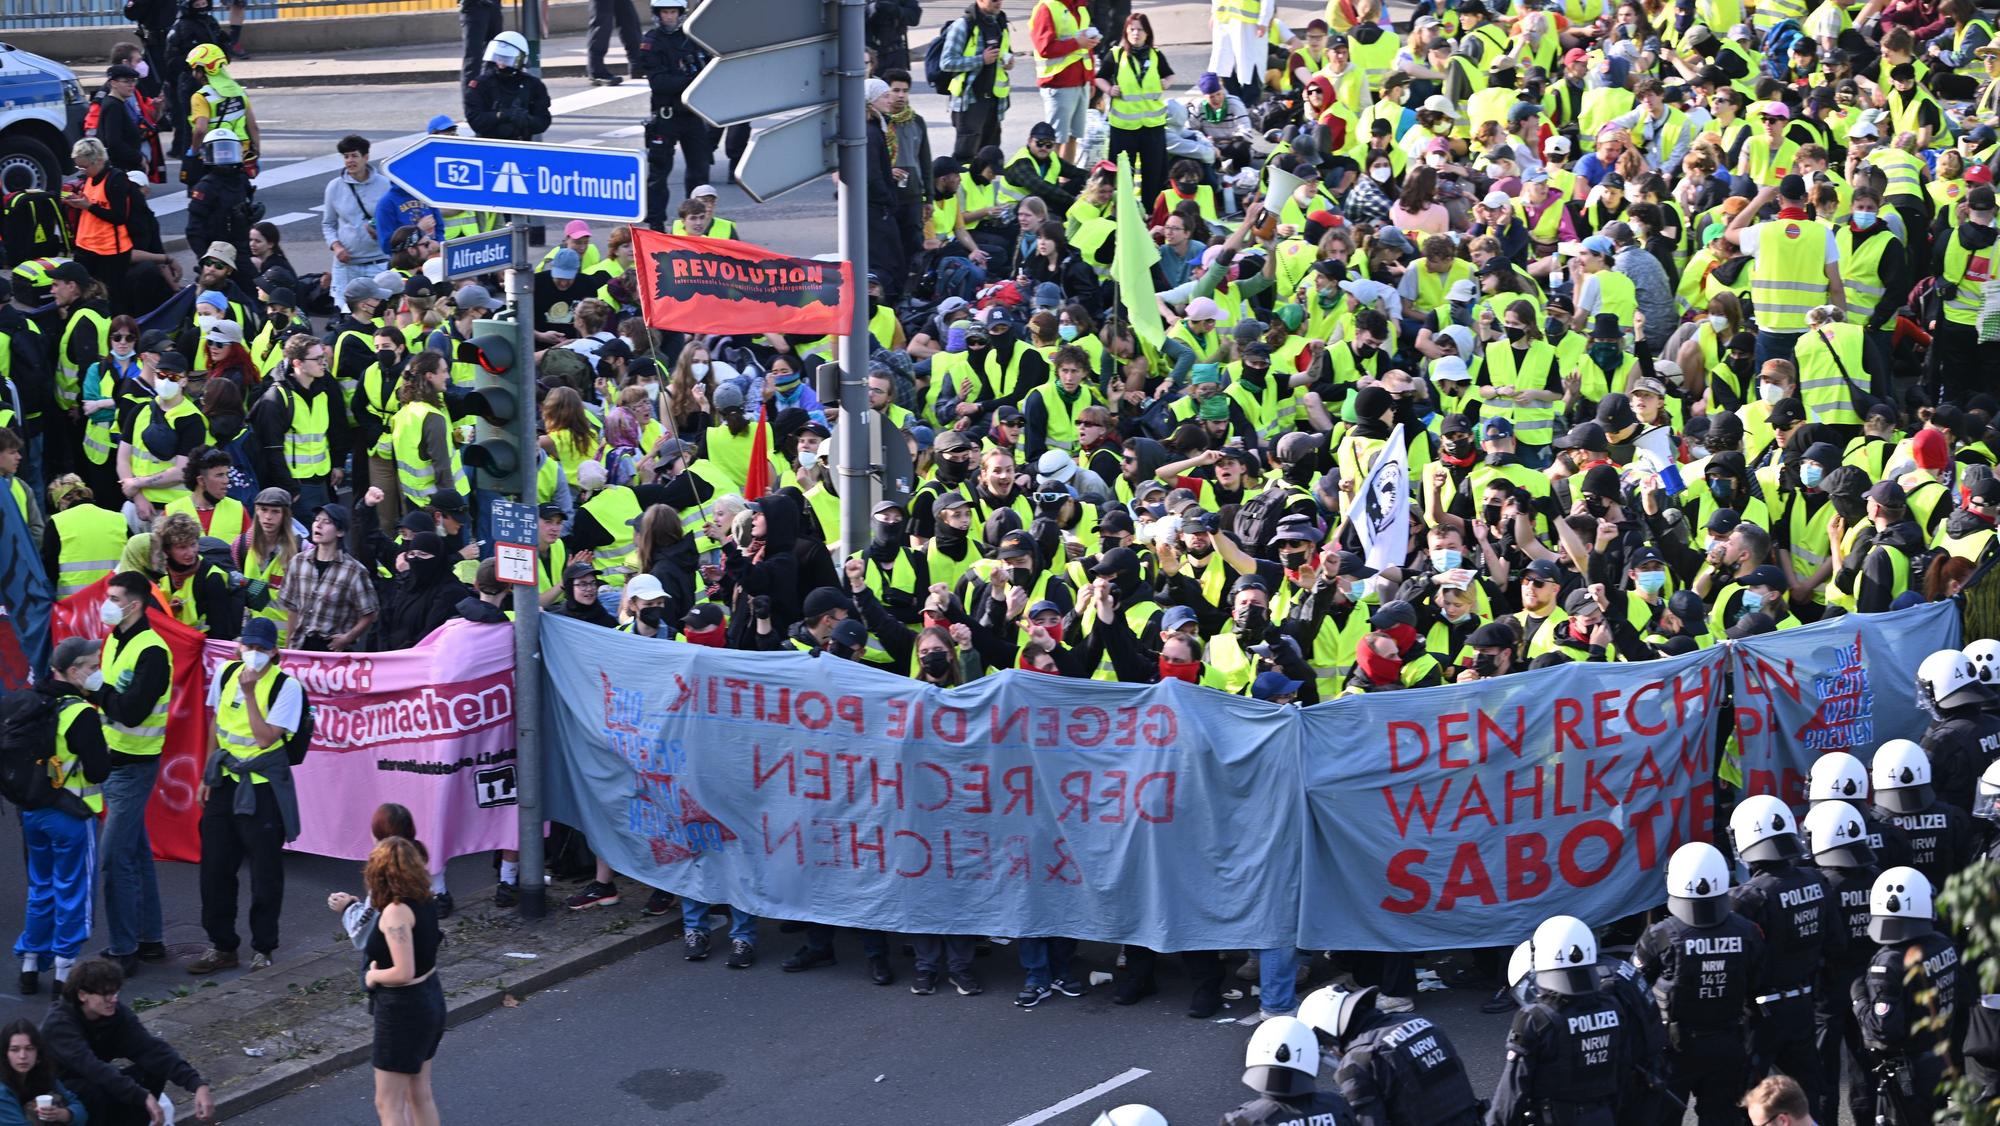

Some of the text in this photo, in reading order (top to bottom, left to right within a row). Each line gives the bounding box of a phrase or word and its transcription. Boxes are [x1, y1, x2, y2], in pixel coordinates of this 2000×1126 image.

[447, 164, 637, 201] 52 Dortmund
[452, 243, 509, 269] Alfredstr.
[672, 258, 823, 287] REVOLUTION
[1954, 667, 1964, 680] 4
[1815, 667, 1872, 700] RECHTE
[1823, 693, 1874, 734] WELLE
[1387, 705, 1526, 774] DEN
[1803, 720, 1874, 750] BRECHEN
[1887, 768, 1897, 782] 4
[1831, 779, 1841, 792] 4
[1754, 821, 1763, 834] 4
[1836, 824, 1846, 838] 4
[1893, 813, 1947, 831] POLIZEI
[1684, 877, 1718, 894] 4 1
[1779, 882, 1824, 909] POLIZEI
[1904, 896, 1912, 911] 1
[1794, 906, 1819, 925] NRW
[1798, 923, 1819, 939] 1412
[1685, 936, 1742, 956] POLIZEI
[1554, 949, 1564, 964] 4
[1701, 960, 1726, 972] NRW
[1700, 972, 1727, 986] 1412
[1699, 985, 1726, 999] FLT
[1568, 1010, 1619, 1035] POLIZEI
[1382, 1017, 1434, 1049] POLIZEI
[1408, 1035, 1438, 1059] NRW
[1581, 1034, 1610, 1052] NRW
[1421, 1048, 1447, 1069] 1412
[1584, 1049, 1609, 1066] 1412
[1278, 1112, 1336, 1126] IZEI
